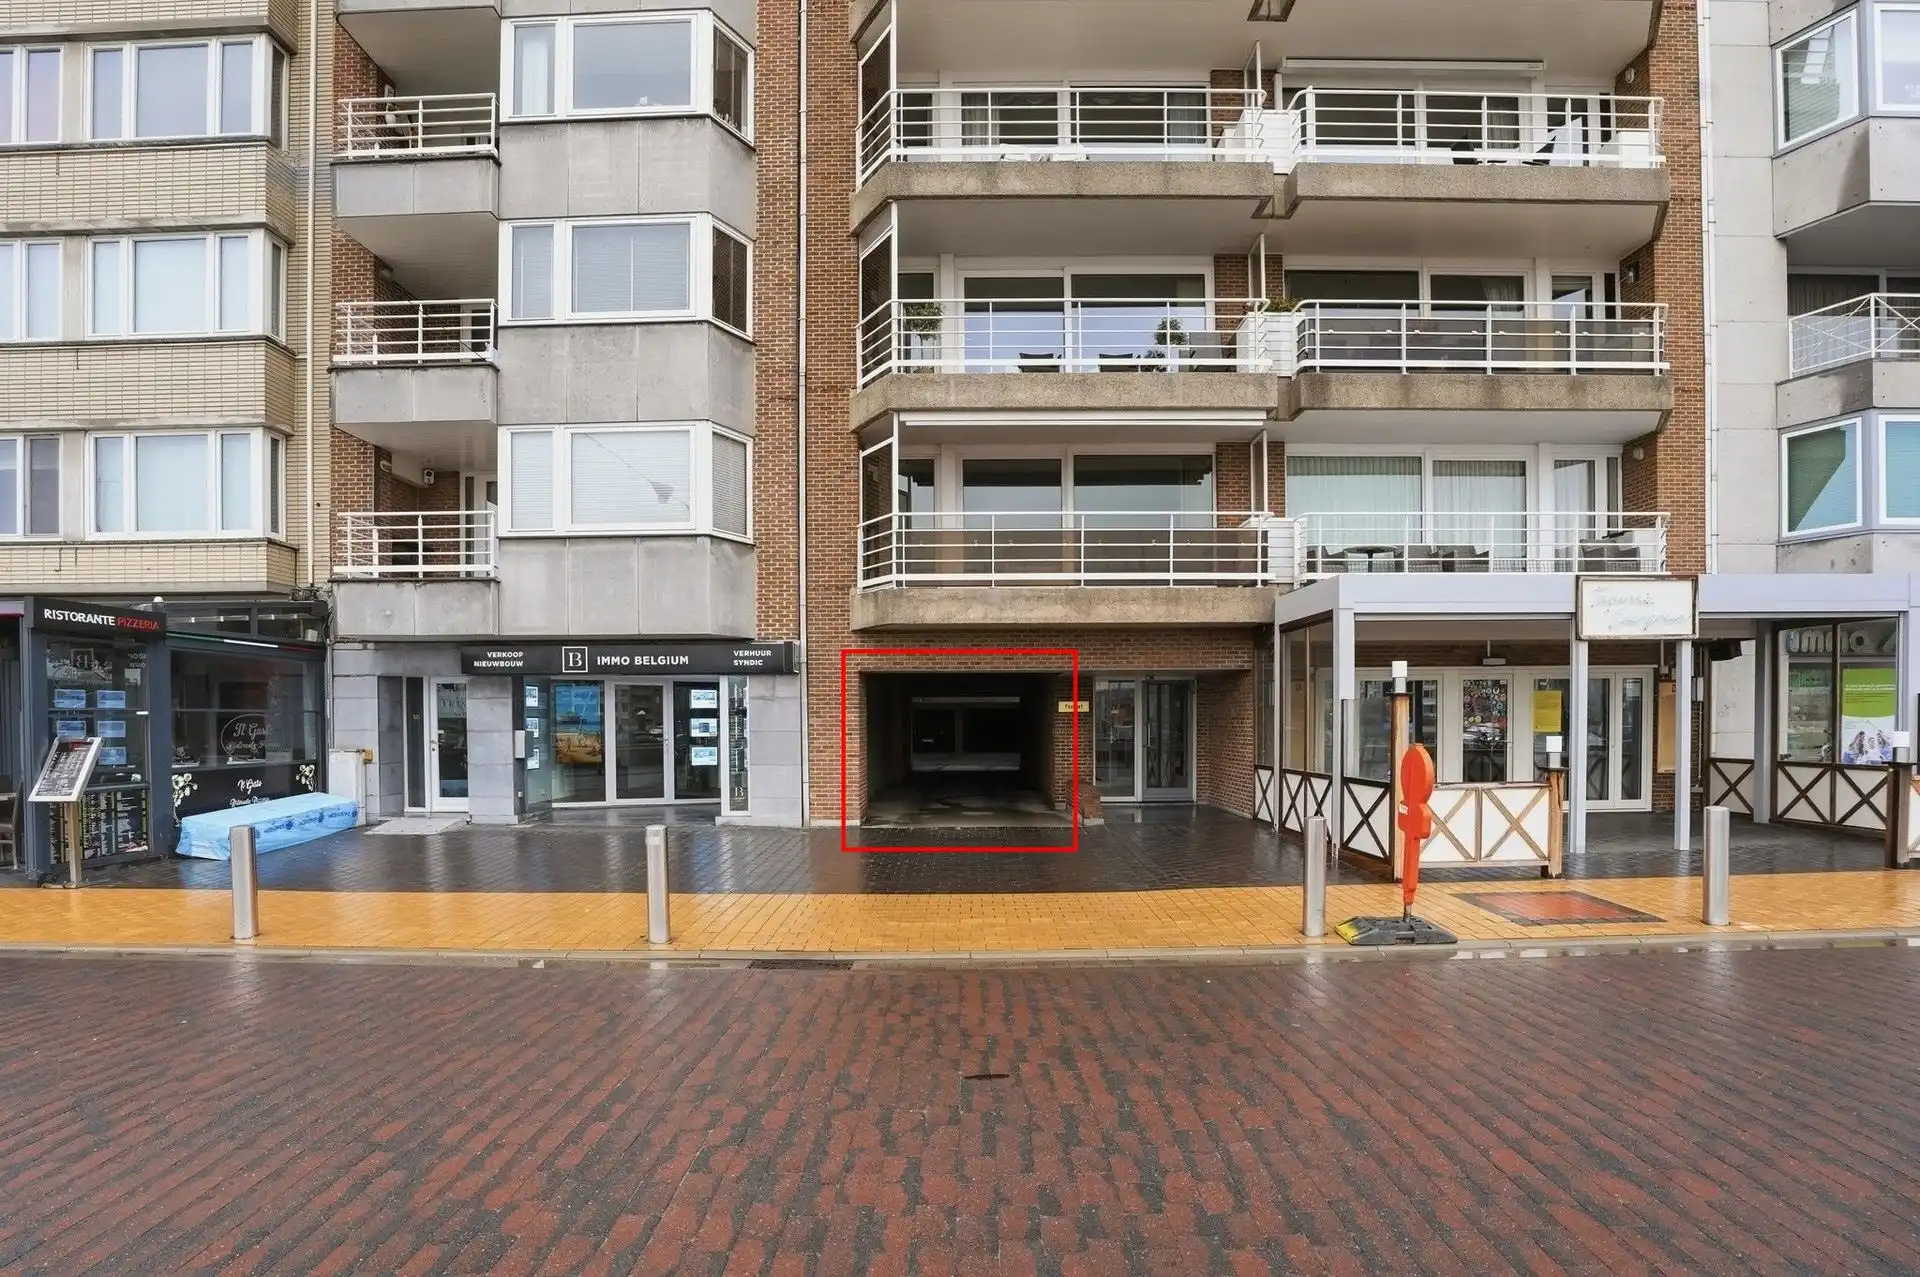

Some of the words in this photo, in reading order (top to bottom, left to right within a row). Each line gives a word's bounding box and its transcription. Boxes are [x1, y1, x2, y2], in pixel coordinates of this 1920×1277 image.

[44, 608, 116, 626] RISTORANTE
[117, 616, 160, 631] PIZZERIA
[473, 660, 524, 668] NIEUWBOUW
[597, 656, 631, 666] IMMO
[634, 655, 689, 666] BELGIUM
